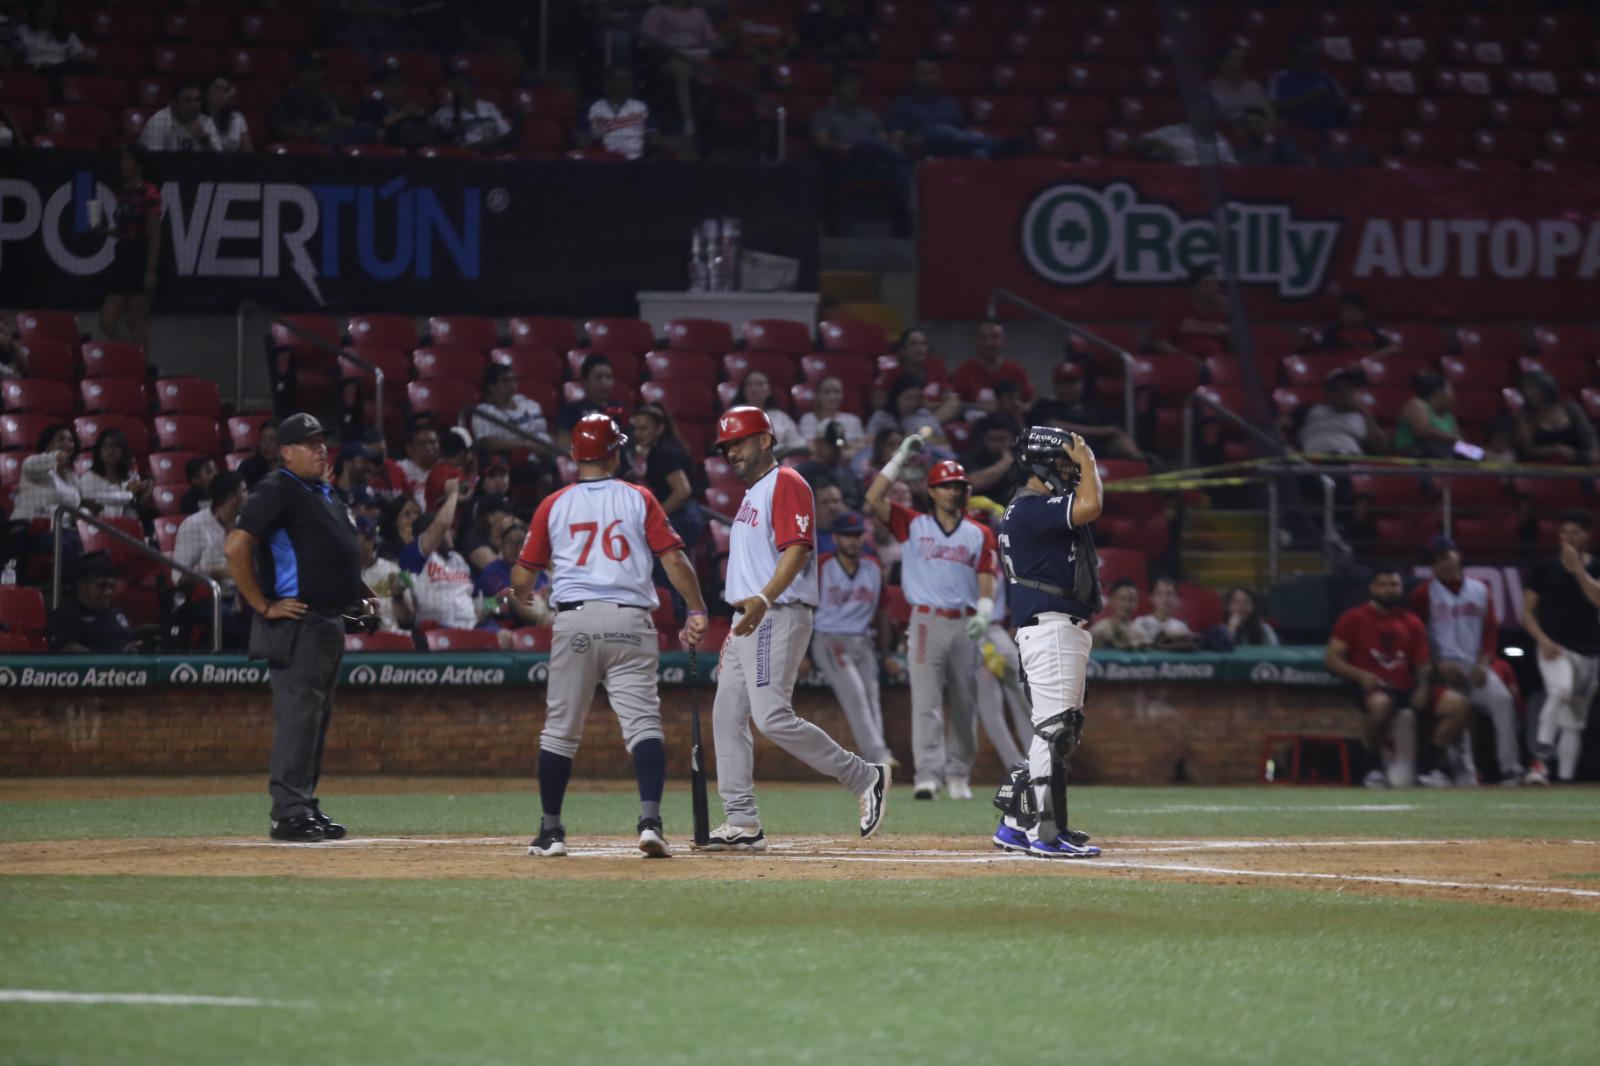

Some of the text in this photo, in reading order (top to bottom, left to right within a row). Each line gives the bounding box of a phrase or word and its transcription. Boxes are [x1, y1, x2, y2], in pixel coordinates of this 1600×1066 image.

[1021, 182, 1340, 297] O'Reilly
[569, 519, 631, 567] 76
[20, 667, 147, 686] Banco Azteca
[202, 664, 259, 682] Banco
[379, 665, 504, 684] Banco Azteca
